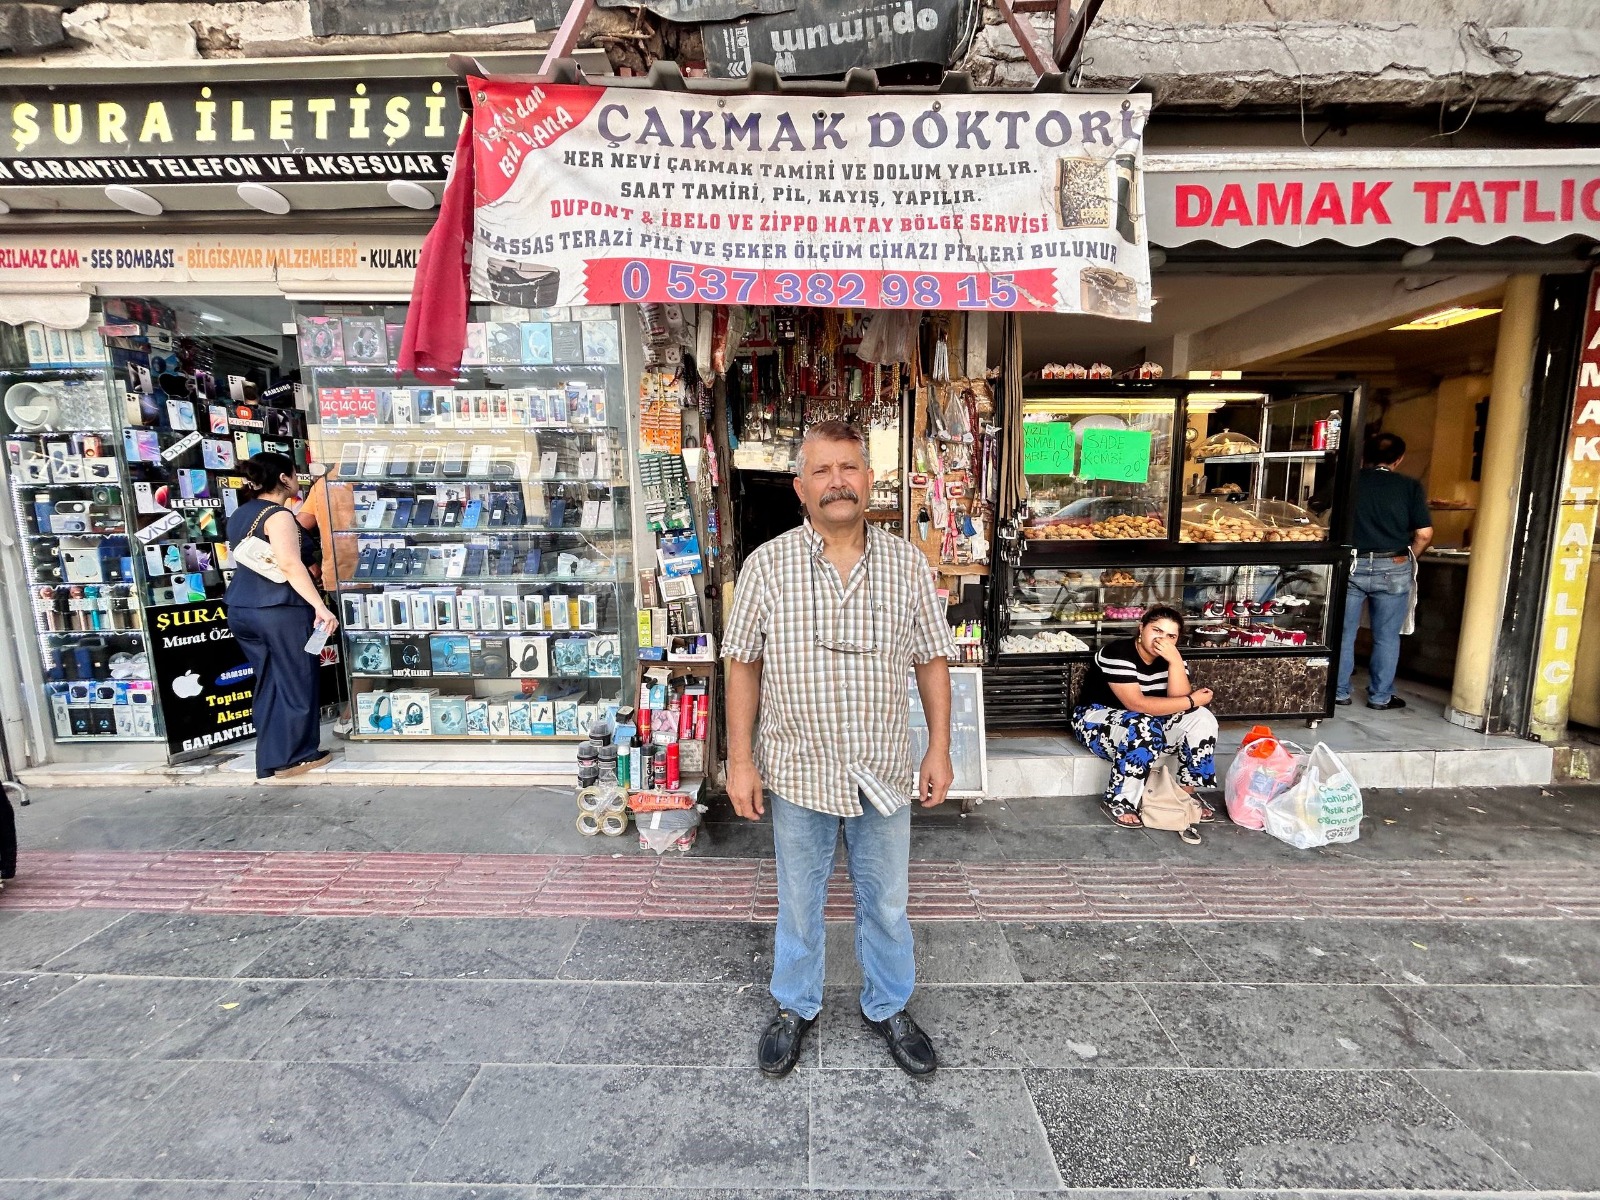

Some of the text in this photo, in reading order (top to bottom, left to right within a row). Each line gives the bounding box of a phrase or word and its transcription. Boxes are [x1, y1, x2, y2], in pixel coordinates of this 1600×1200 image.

[770, 1, 939, 51] optimum
[12, 82, 468, 153] ŞURA İLETİŞİ
[597, 104, 848, 152] ÇAKMAK
[145, 156, 262, 178] TELEFON
[262, 156, 301, 176] VE
[304, 154, 438, 176] AKSESUAR
[563, 149, 1038, 182] HER NEVİ ÇAKMAK TAMİRİ VE DOLUM YAPILIR.
[620, 180, 982, 207] SAAT TAMİRİ, PİL, KAYIŞ, YAPILIR.
[1175, 181, 1394, 228] DAMAK
[550, 199, 1049, 234] DUPONT & İBELO VE ZİPPO HATAY BÖLGE SERVİSİ
[50, 249, 80, 269] CAM
[91, 249, 113, 269] SES
[116, 249, 175, 269] BOMBASI
[187, 242, 263, 269] BİLGİSAYAR
[265, 242, 358, 269] MALZEMELERİ
[369, 249, 423, 269] KULAKL
[559, 227, 634, 251] TERAZİ
[640, 232, 683, 254] PİLİ
[690, 241, 716, 258] VE
[722, 241, 787, 263] ŞEKER
[794, 239, 863, 263] ÖLÇÜM
[869, 239, 938, 261] CİHAZI
[944, 240, 1025, 264] PİLLERİ
[1031, 240, 1118, 265] BULUNUR
[621, 261, 1019, 308] 0 537 382 98 15
[263, 383, 291, 397] SAMSUNG
[320, 401, 339, 411] 14C
[340, 401, 358, 411] 14C
[359, 401, 376, 411] 14C
[1086, 433, 1125, 450] SADE
[1542, 486, 1594, 717] TATLICI
[156, 606, 229, 632] ŞURA
[162, 627, 235, 649] Murat ÖZ
[205, 690, 252, 707] Toptan
